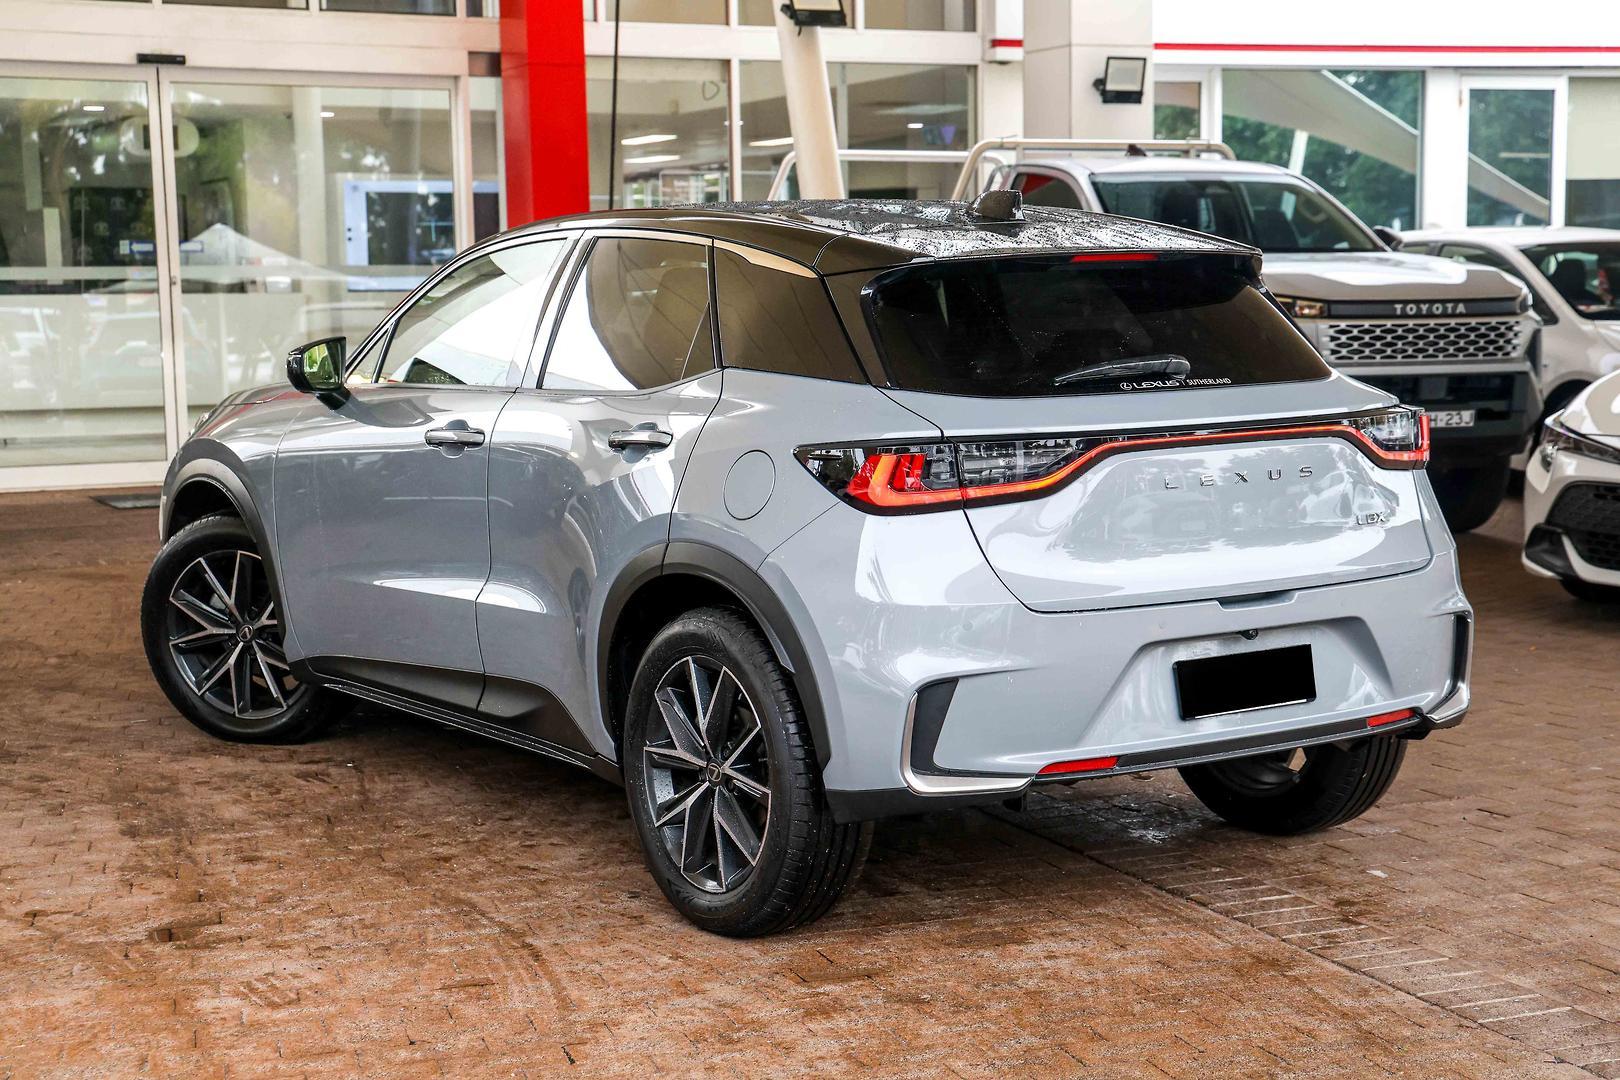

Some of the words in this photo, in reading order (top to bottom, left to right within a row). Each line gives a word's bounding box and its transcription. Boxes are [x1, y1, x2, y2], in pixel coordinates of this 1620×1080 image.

[1394, 303, 1466, 315] TOYOTA
[1134, 379, 1180, 389] LEXUS
[1187, 378, 1232, 386] SUTHERLAND
[1164, 466, 1313, 490] LEXUS
